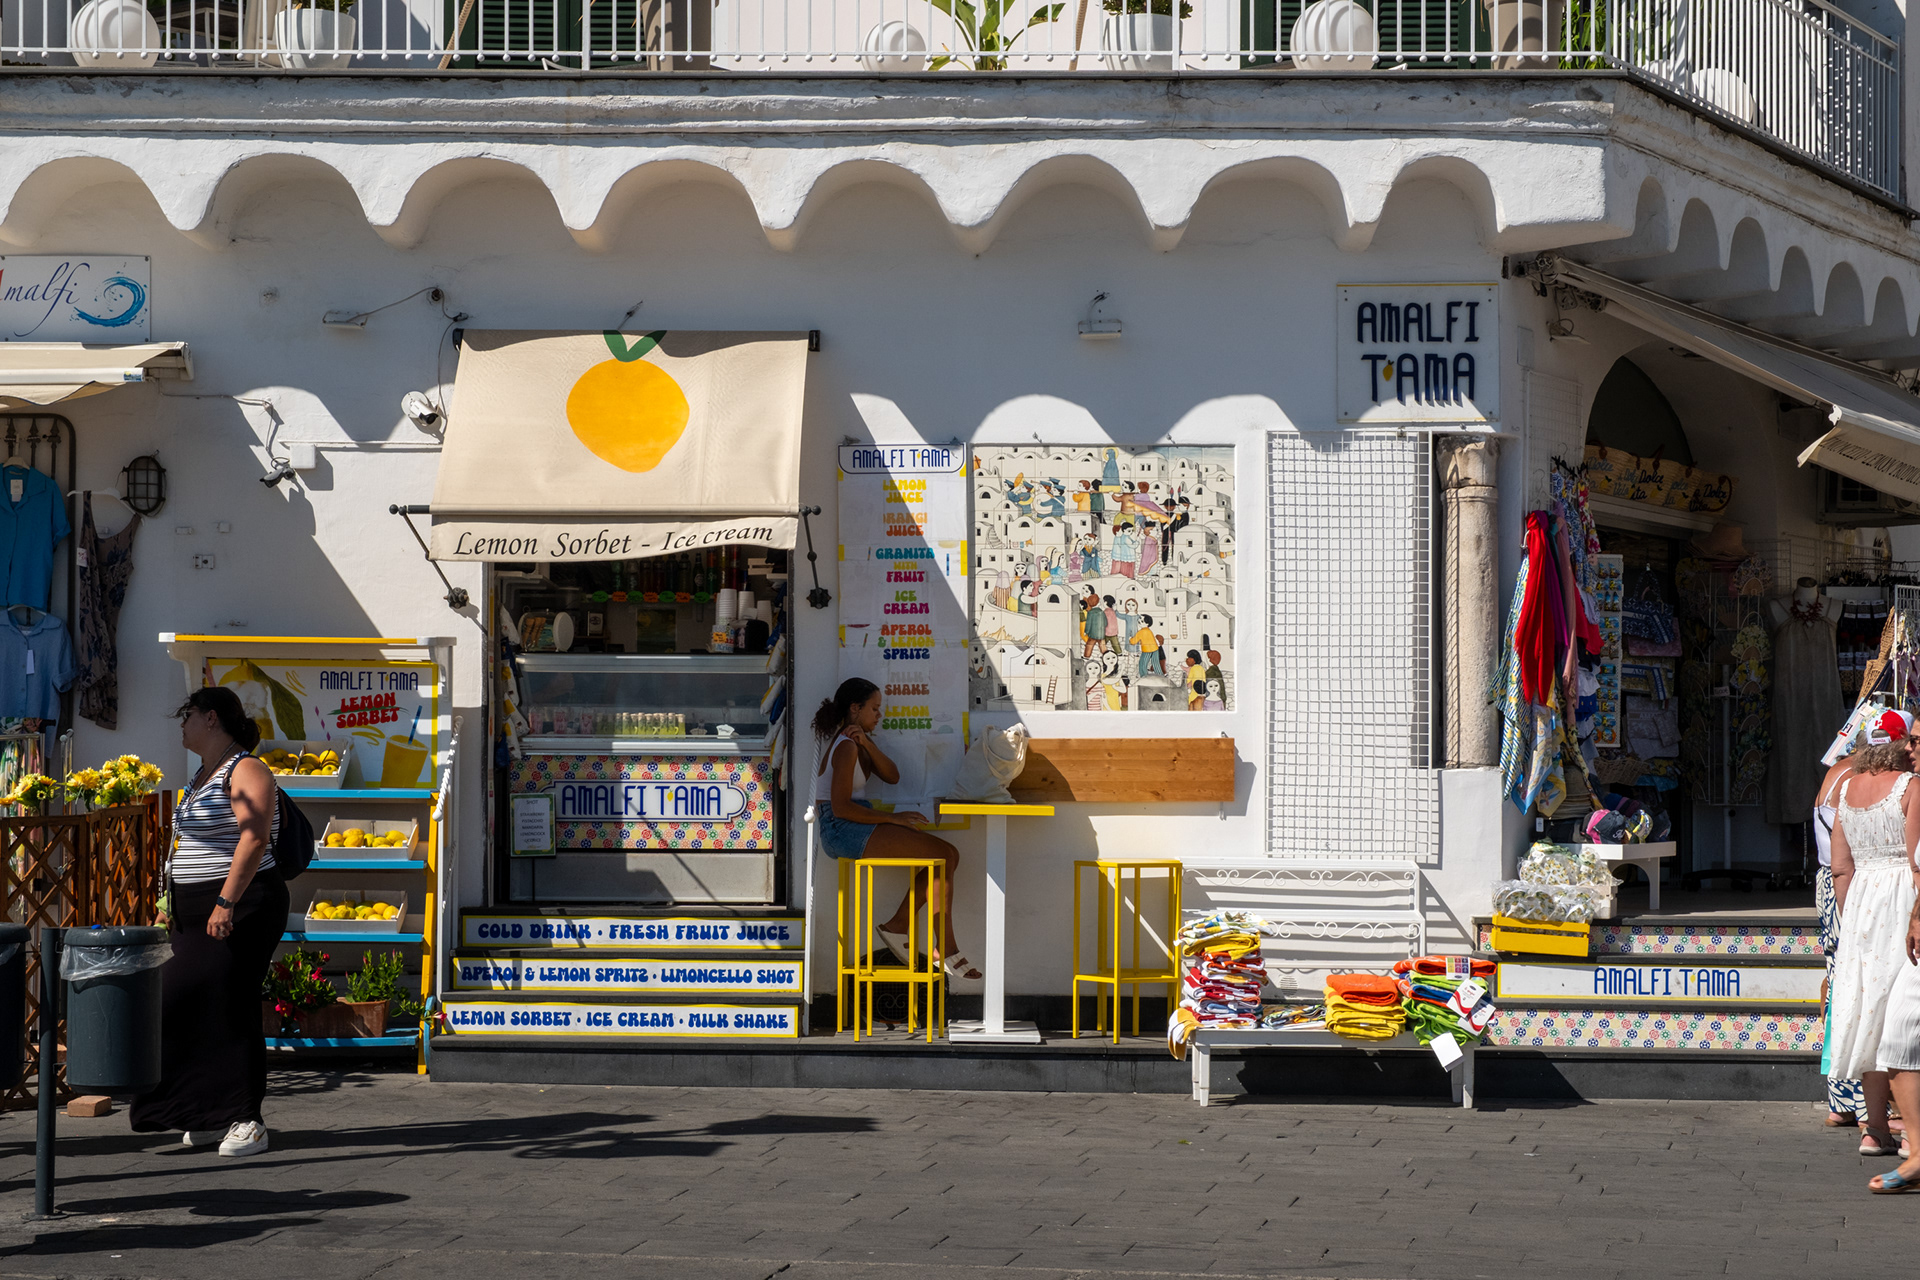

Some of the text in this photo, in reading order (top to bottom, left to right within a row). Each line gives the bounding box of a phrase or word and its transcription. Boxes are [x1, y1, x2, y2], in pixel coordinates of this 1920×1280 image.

[0, 262, 90, 337] malfi
[1357, 302, 1480, 343] AMALFI
[852, 449, 906, 468] AMALFI
[1639, 469, 1664, 483] Dolce
[882, 479, 927, 491] LEMON
[886, 492, 923, 503] JUICE
[886, 525, 924, 536] JUICE
[453, 531, 538, 556] Lemon
[550, 530, 632, 558] Sorbet
[660, 531, 696, 552] Ice
[702, 526, 774, 545] cream
[876, 548, 935, 559] GRANITA
[894, 561, 917, 570] WITH
[886, 571, 925, 582] FRUIT
[895, 591, 917, 602] ICE
[884, 603, 930, 614] CREAM
[880, 624, 932, 636] APEROL
[878, 636, 935, 648] & LEMON
[320, 671, 373, 690] AMALFI
[890, 672, 924, 682] MILK
[884, 684, 930, 696] SHAKE
[340, 692, 396, 712] LEMON
[884, 706, 930, 717] LEMON
[336, 707, 400, 729] SORBET
[882, 718, 932, 730] SORBET
[562, 785, 647, 815] AMALFI
[478, 924, 790, 941] COLD DRINK FRESH FRUIT JUICE
[461, 966, 520, 981] APEROL
[524, 966, 535, 981] &
[540, 966, 590, 982] LEMON
[660, 968, 753, 984] LIMONCELLO
[756, 968, 795, 984] SHOT
[1593, 966, 1672, 996] AMALFI
[451, 1010, 789, 1029] LEMON SORBET ICE CREAM MILK SHAKE
